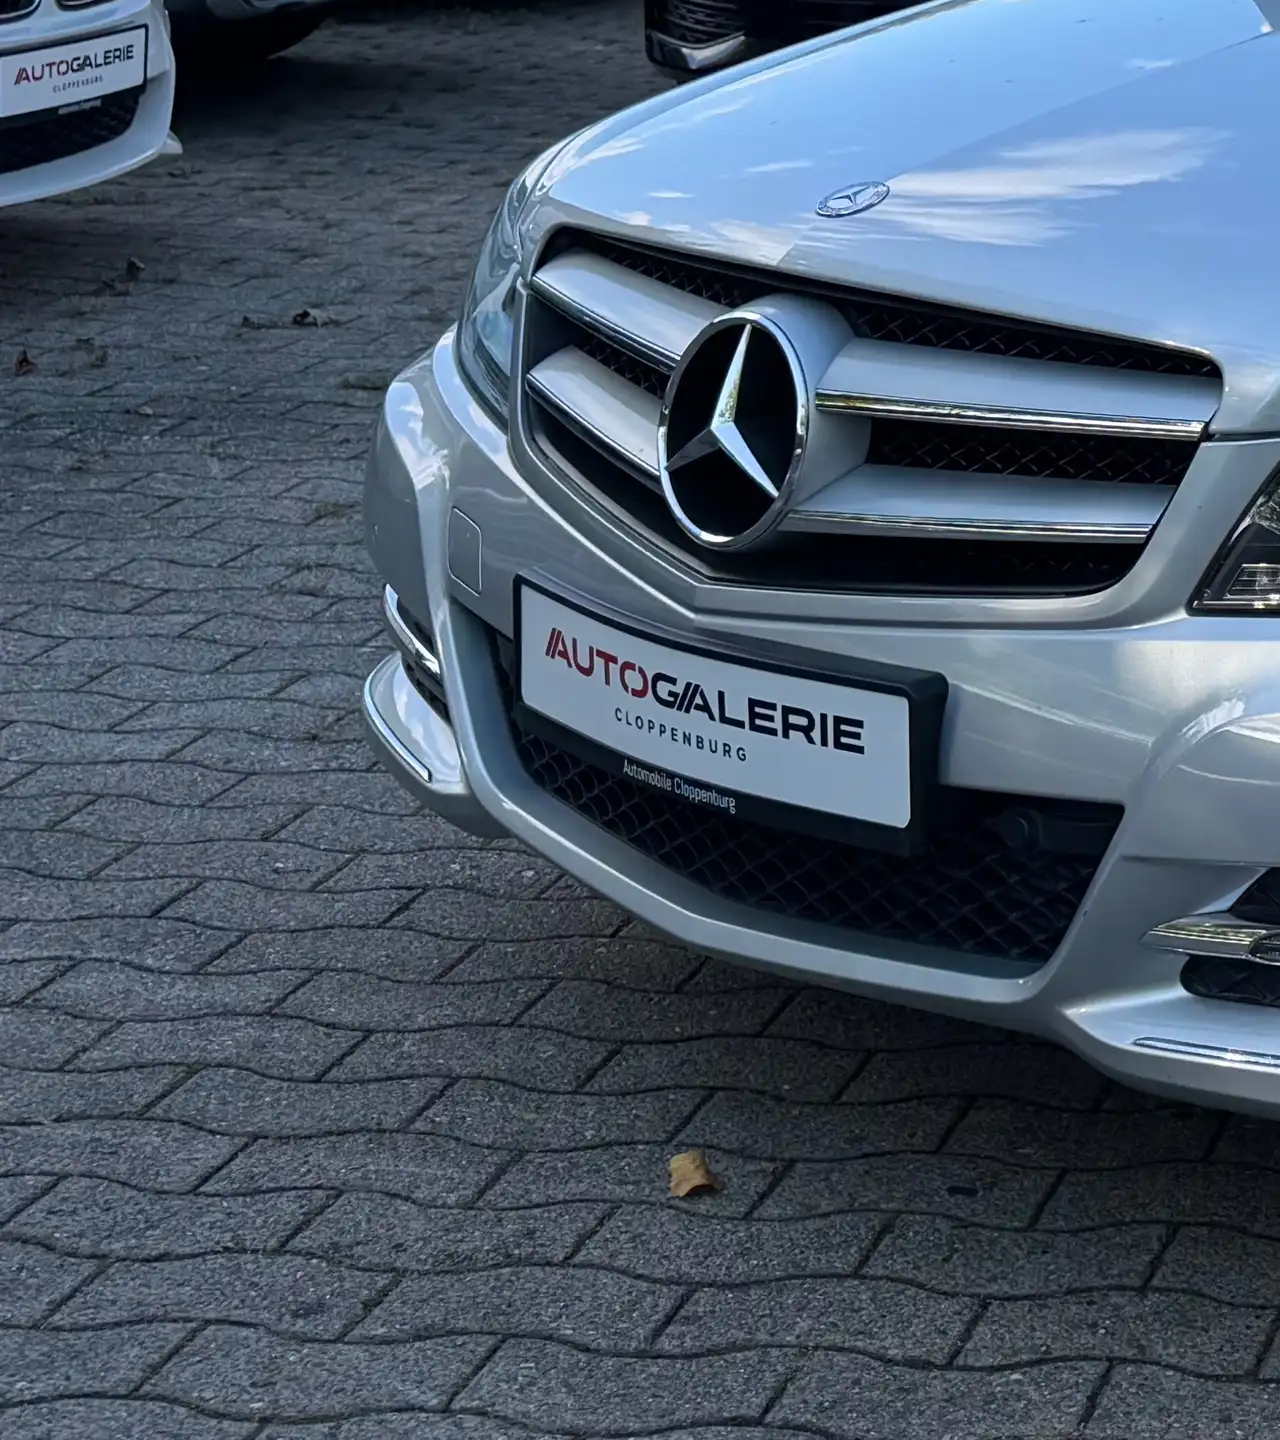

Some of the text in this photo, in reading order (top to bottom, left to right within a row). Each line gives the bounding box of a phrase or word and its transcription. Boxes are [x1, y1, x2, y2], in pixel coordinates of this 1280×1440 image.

[14, 44, 135, 86] AUTOGALERIE
[544, 627, 866, 755] AUTOGALERIE
[614, 707, 748, 762] CLOPPENBURG
[623, 759, 736, 815] Automobile Cloppenburg
